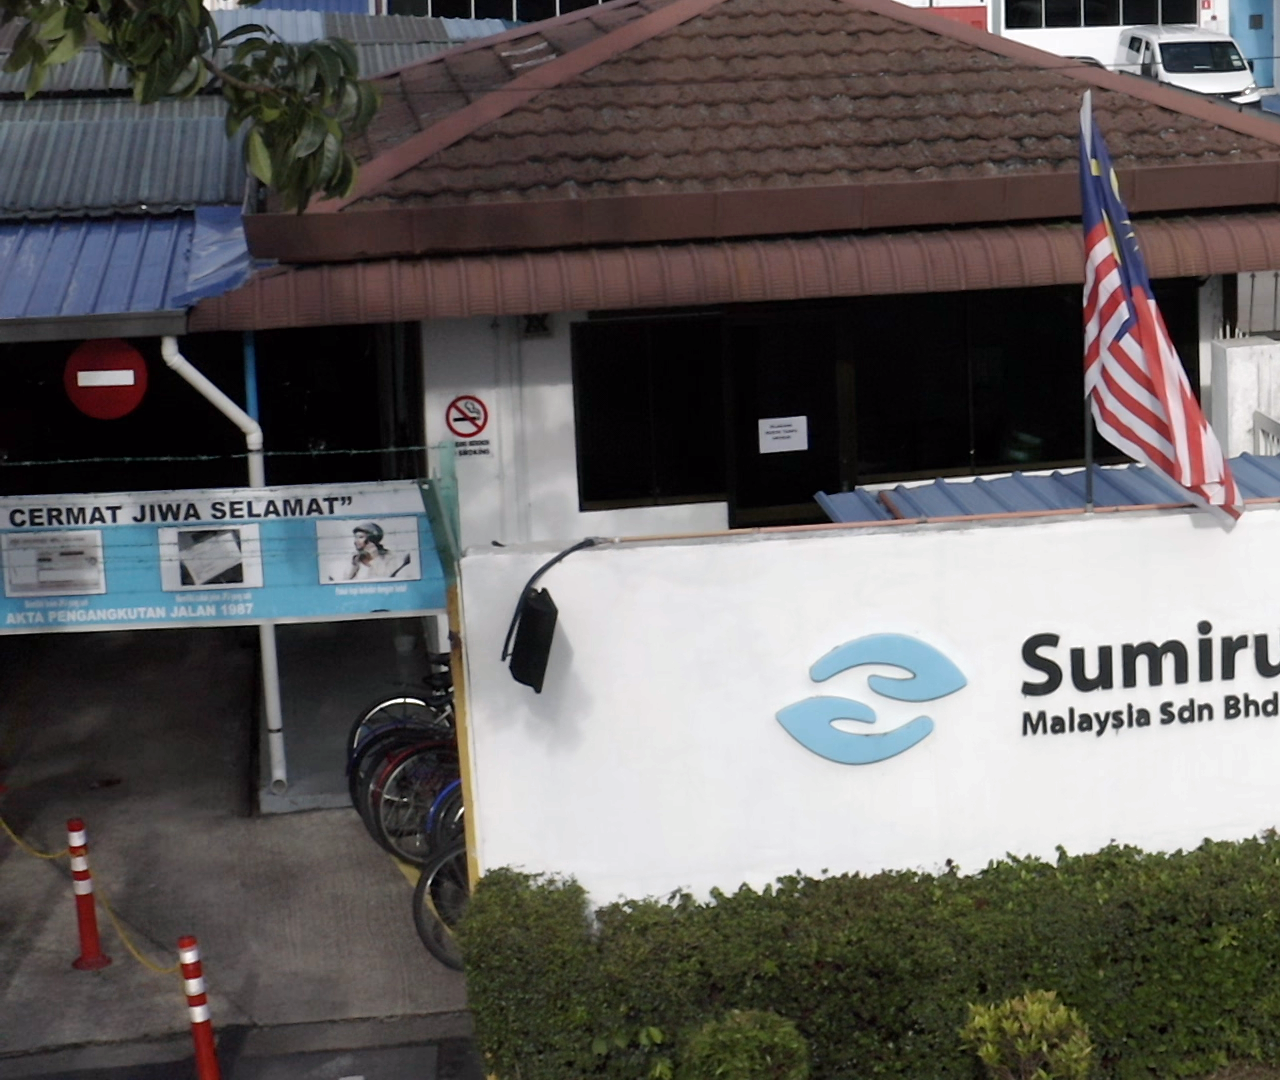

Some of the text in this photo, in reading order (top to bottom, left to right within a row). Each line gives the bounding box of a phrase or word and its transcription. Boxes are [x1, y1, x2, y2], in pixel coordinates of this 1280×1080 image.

[9, 506, 122, 527] CERMAT
[132, 503, 201, 522] JIWA
[6, 602, 254, 625] AKTA PENGANGKUTAN JALAN 1987
[1021, 693, 1280, 738] Malaysia Sdn Bhd
